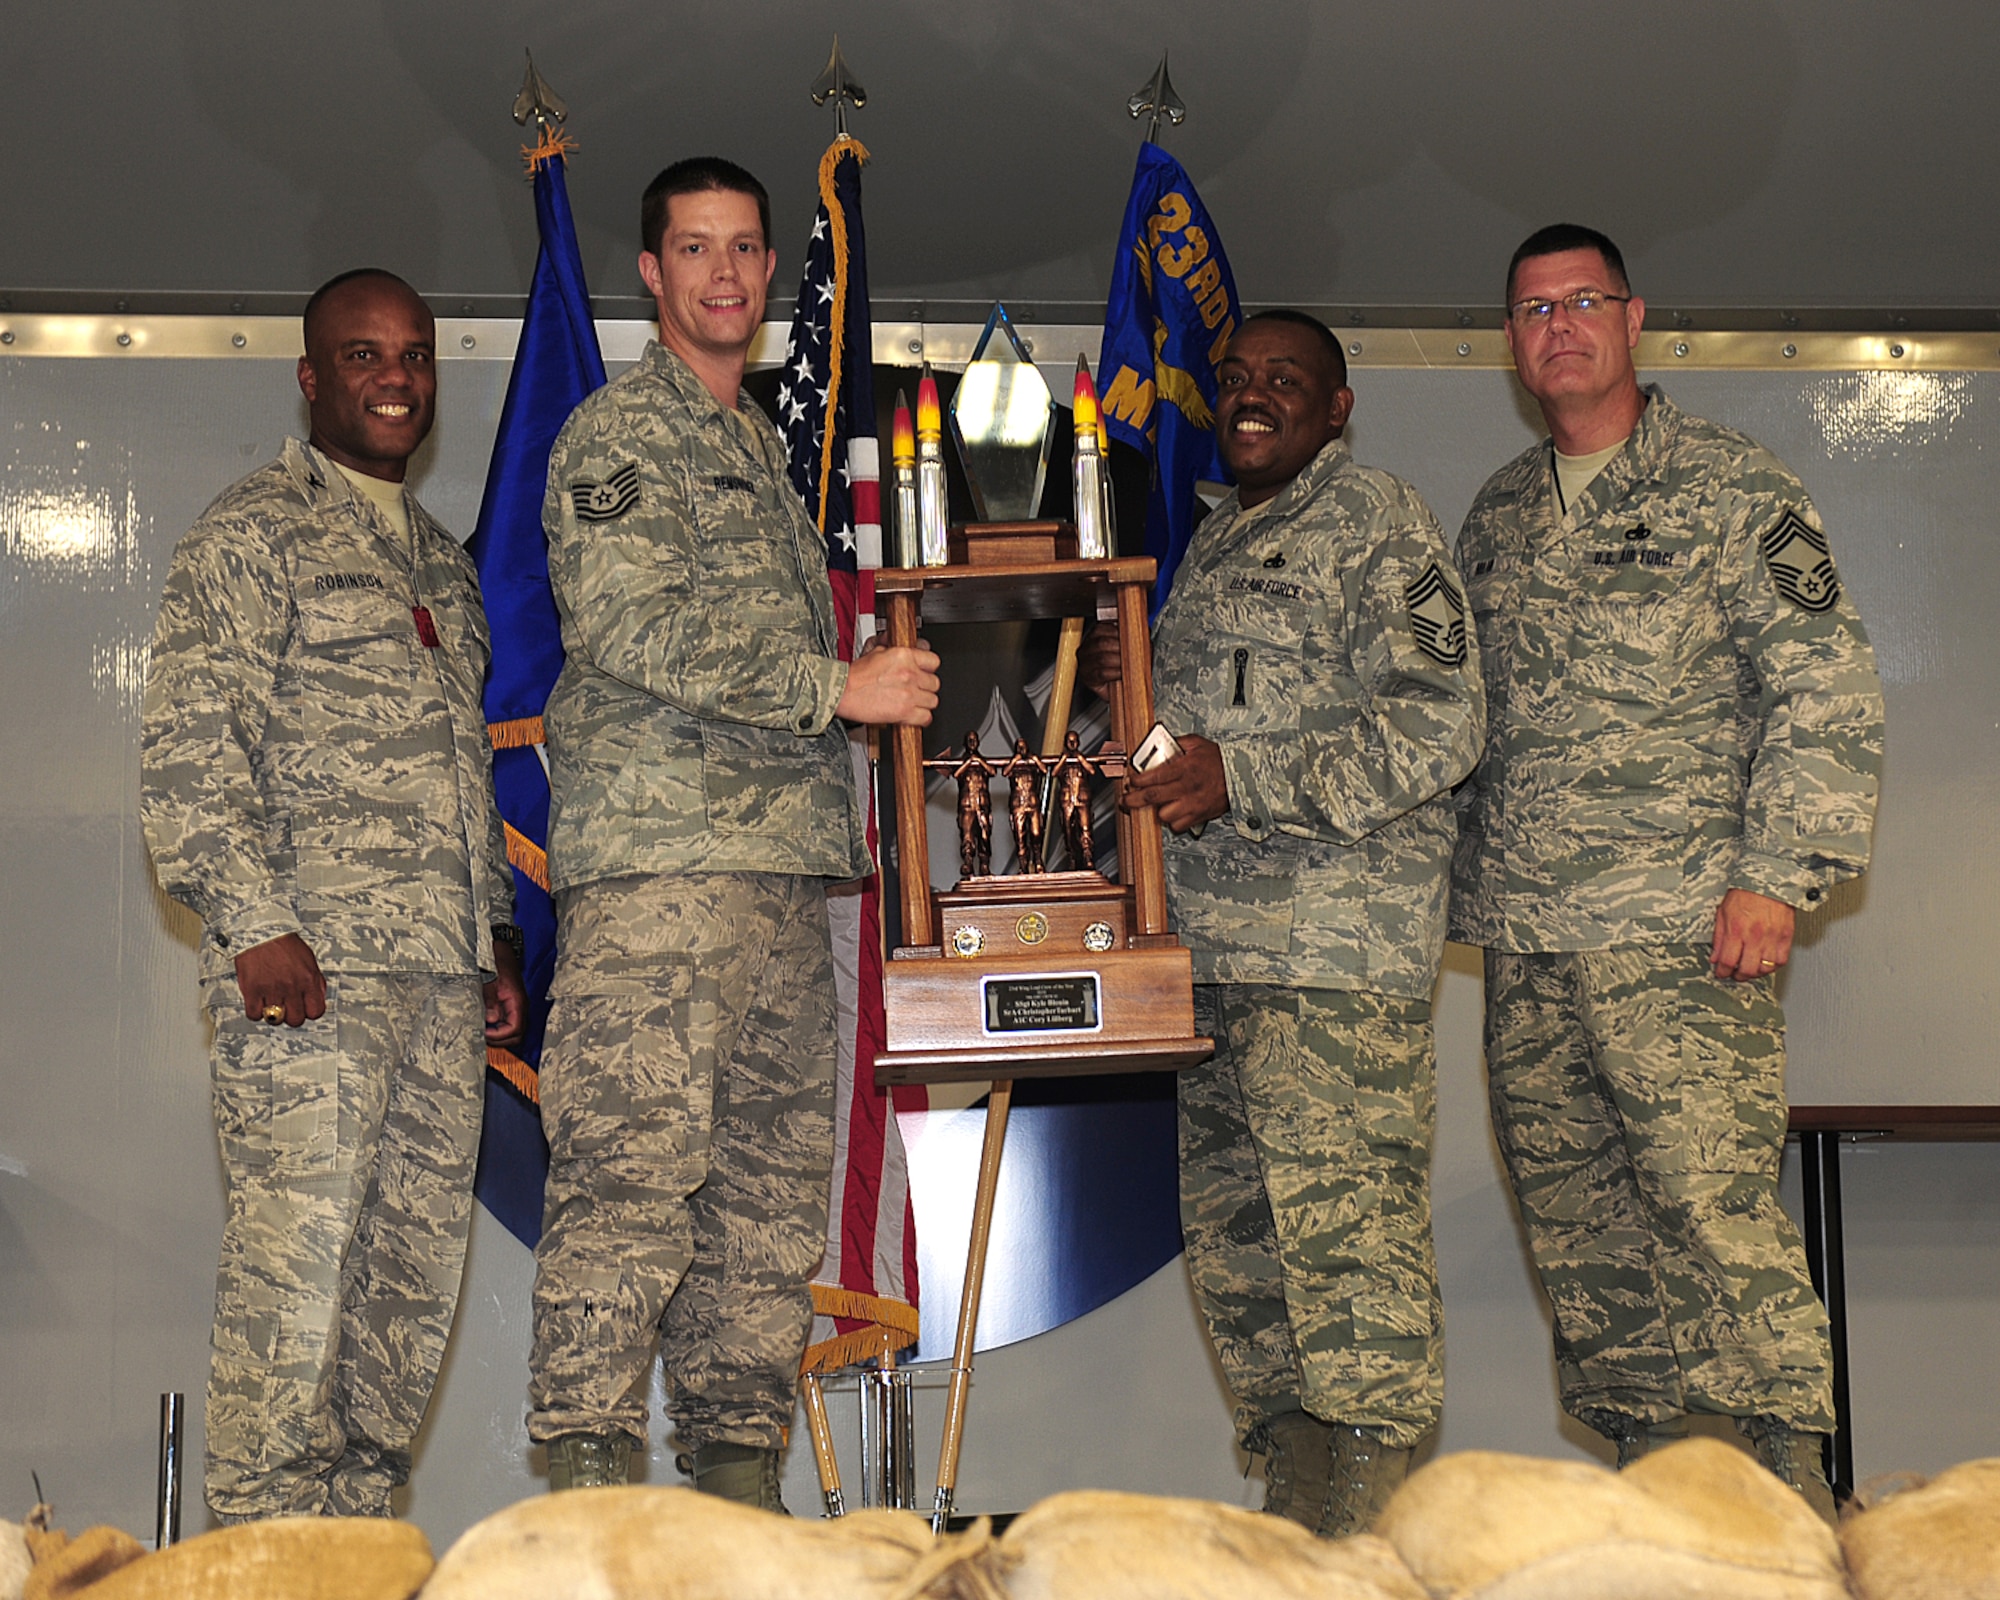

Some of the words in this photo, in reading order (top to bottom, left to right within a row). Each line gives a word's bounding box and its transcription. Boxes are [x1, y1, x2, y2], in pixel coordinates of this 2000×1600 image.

[1148, 192, 1230, 330] 23RD
[1594, 551, 1615, 566] U.S.
[1619, 548, 1637, 564] AIR
[1640, 549, 1677, 566] FORCE
[314, 574, 385, 591] ROBINSON
[1246, 577, 1265, 592] AIR
[1264, 580, 1303, 600] FORCE
[1031, 1000, 1046, 1008] Kyle
